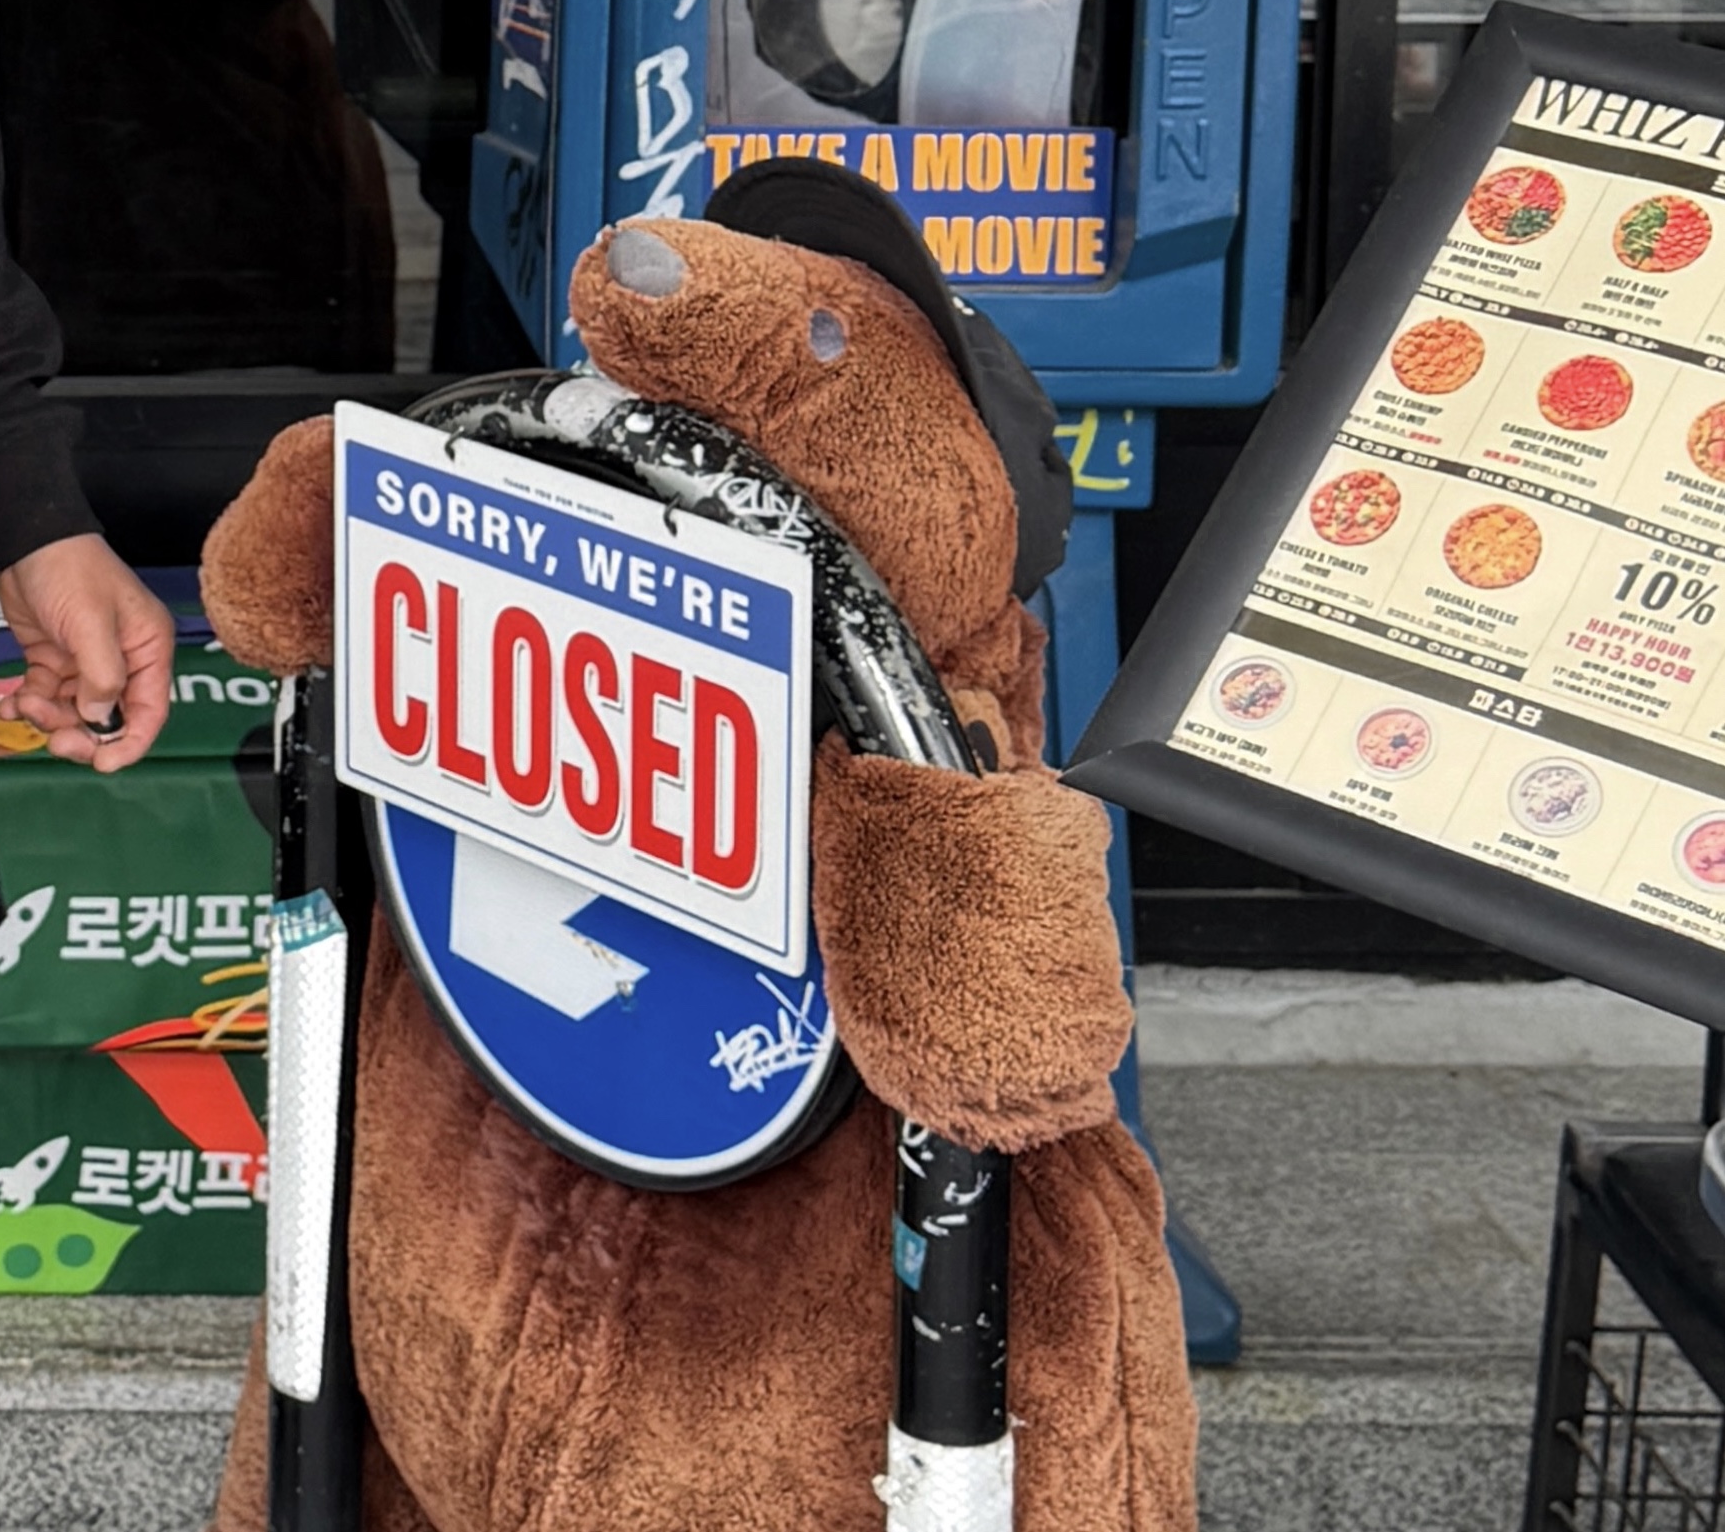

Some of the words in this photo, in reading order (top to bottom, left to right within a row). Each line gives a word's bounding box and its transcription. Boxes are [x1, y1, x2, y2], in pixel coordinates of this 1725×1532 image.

[1533, 76, 1689, 149] WHIZ
[860, 133, 899, 191] A
[912, 132, 1095, 191] MOVIE
[923, 216, 1105, 275] MOVIE
[1665, 469, 1716, 495] SPINACH
[376, 470, 558, 576] SORRY,
[578, 537, 750, 640] WE'RE
[1615, 563, 1719, 626] 10%
[1586, 618, 1644, 644] HAPPY
[1644, 636, 1692, 660] HOUR
[1599, 642, 1696, 684] 13,900원
[169, 673, 278, 706] no
[1469, 689, 1543, 728] 파스타
[374, 561, 758, 891] CLOSED
